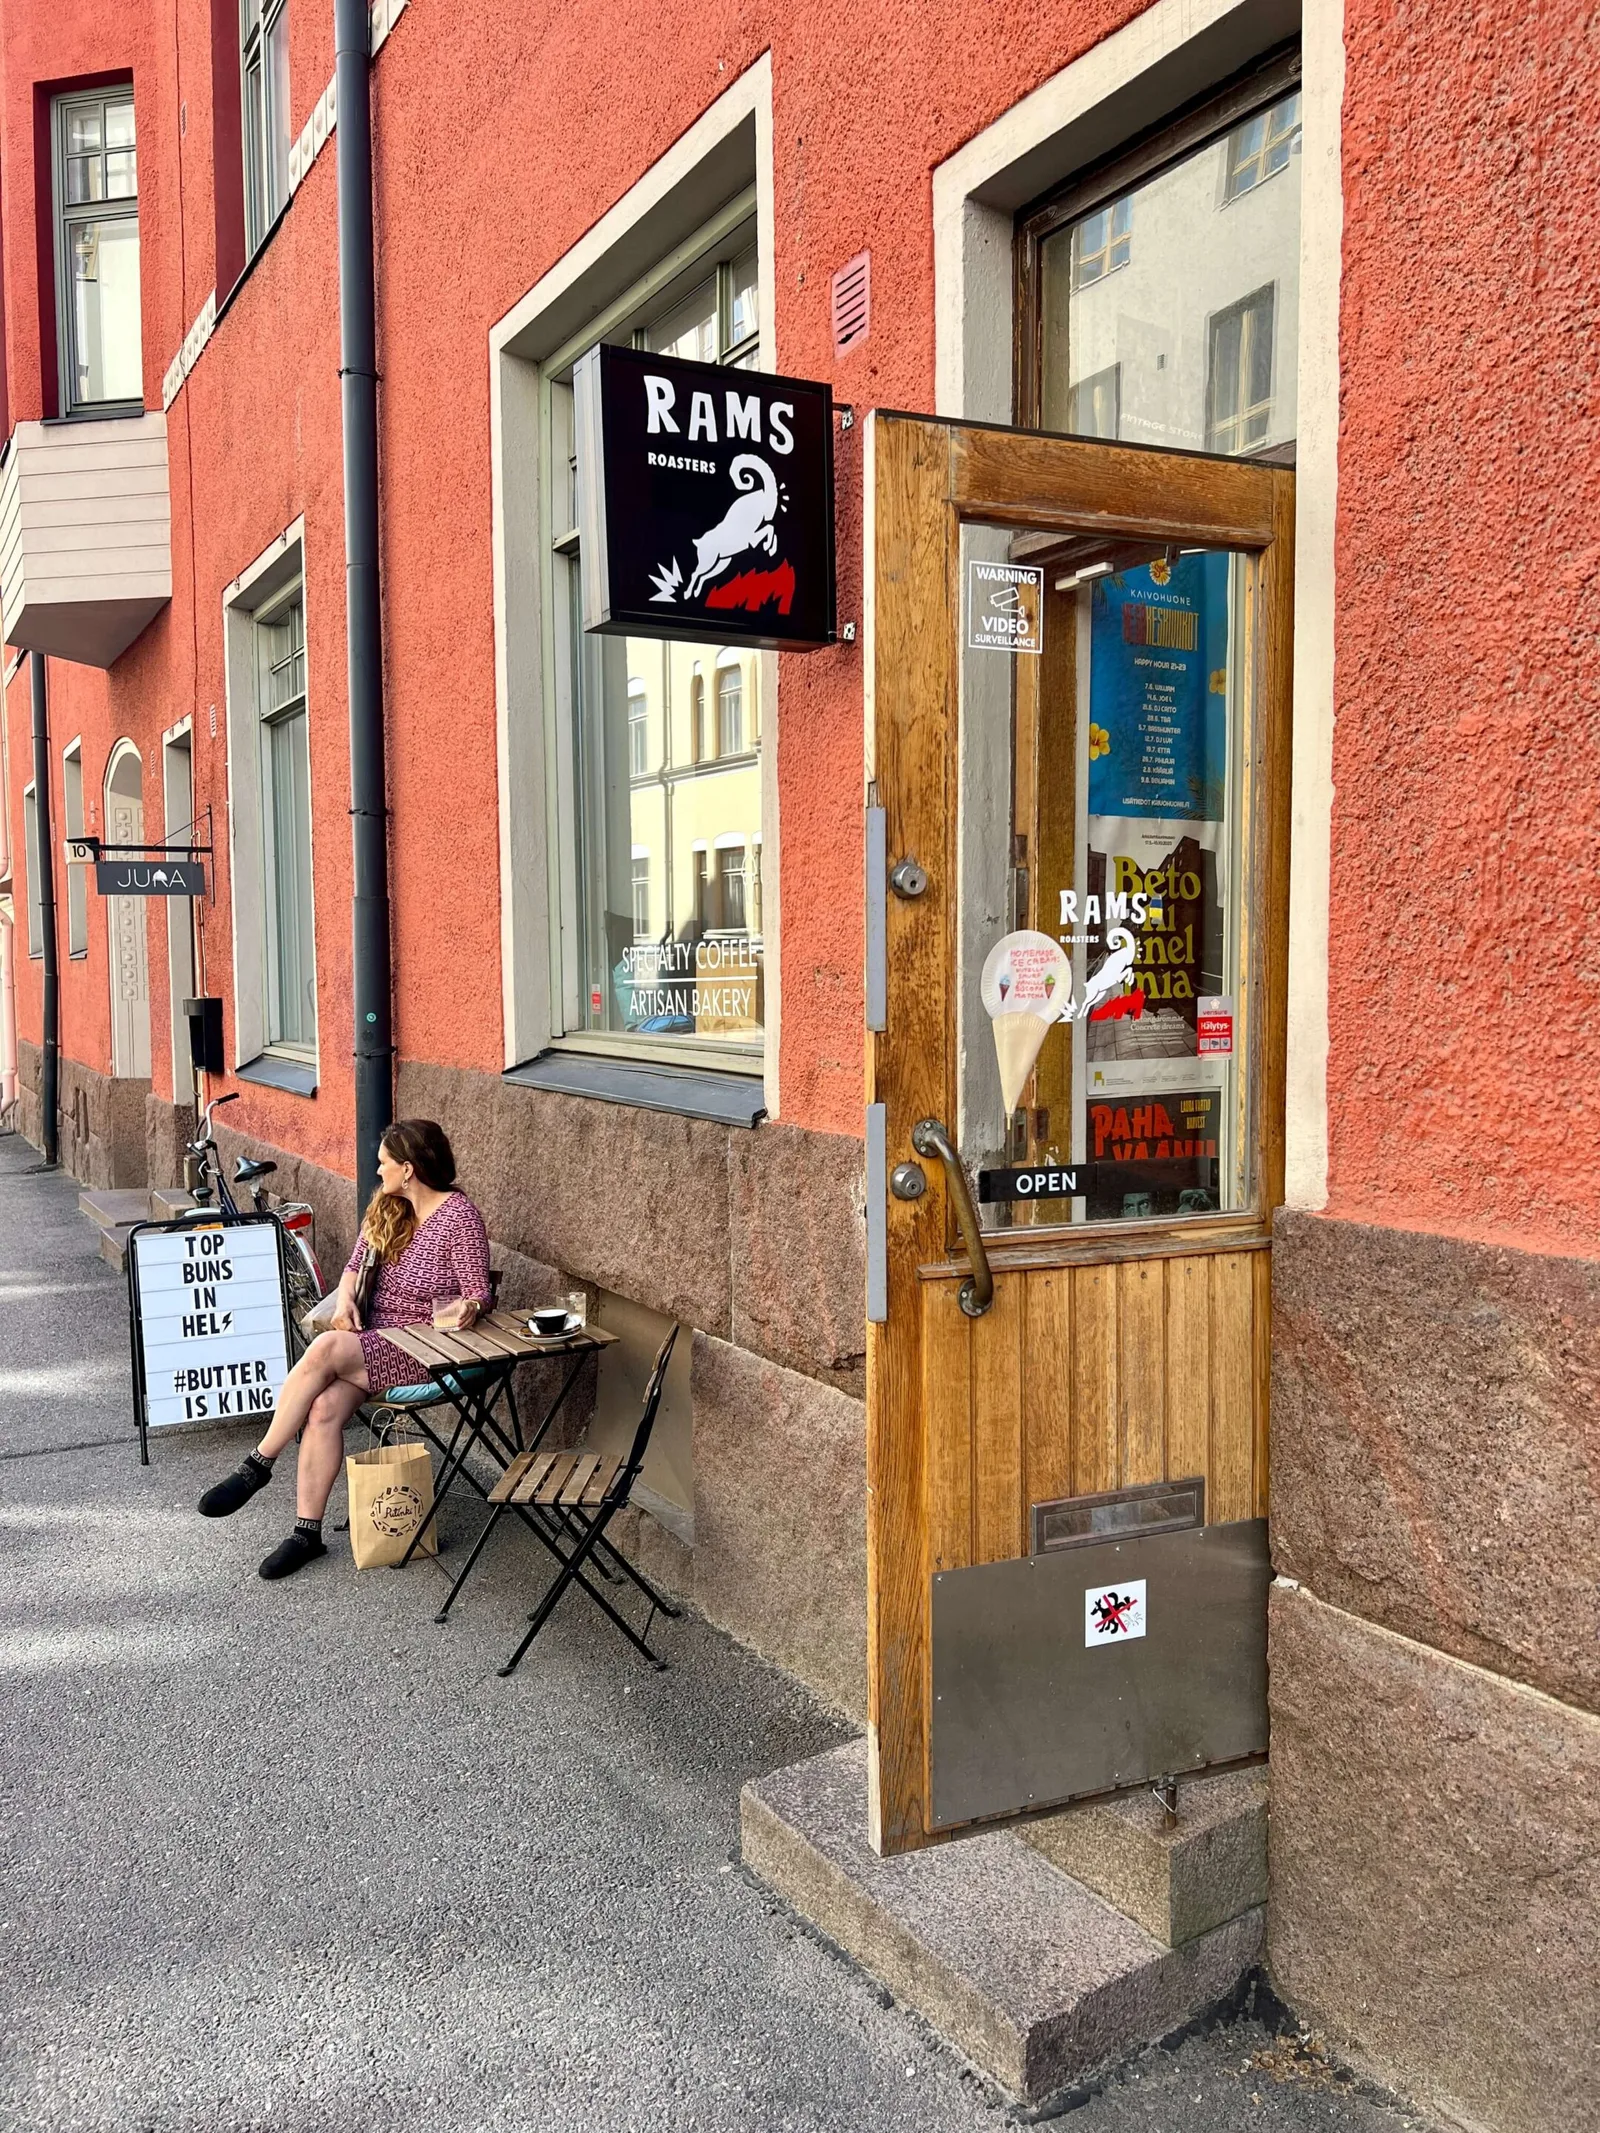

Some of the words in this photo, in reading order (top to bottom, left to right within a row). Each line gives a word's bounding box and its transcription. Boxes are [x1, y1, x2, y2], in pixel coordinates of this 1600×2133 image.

[643, 375, 794, 455] RAMS
[648, 452, 716, 474] ROASTERS
[976, 566, 1037, 585] WARNING
[1130, 588, 1191, 606] KAIVOHUONE
[981, 615, 1029, 635] VIDEO
[974, 633, 1036, 648] SURVEILLANCE
[1134, 657, 1152, 667] HAPPY
[1153, 660, 1170, 669] HOUR
[72, 844, 86, 858] 10
[117, 868, 187, 888] JURA
[1112, 856, 1201, 900] Beto
[1059, 889, 1147, 926] RAMS
[1060, 935, 1099, 943] ROASTERS
[622, 942, 691, 973] SPECIALTY
[695, 939, 758, 969] COFFEE
[1010, 949, 1054, 957] HOMEMADE
[1010, 958, 1024, 967] ICE
[629, 988, 688, 1016] ARTISAN
[692, 987, 752, 1017] BAKERY
[1090, 1103, 1174, 1157] PAHA
[1015, 1171, 1077, 1194] OPEN
[184, 1234, 224, 1258] TOP
[182, 1259, 233, 1284] BUNS
[193, 1286, 216, 1310] IN
[182, 1314, 220, 1338] HEL
[173, 1360, 267, 1393] #BUTTER
[185, 1395, 207, 1420] IS
[218, 1387, 274, 1414] KING
